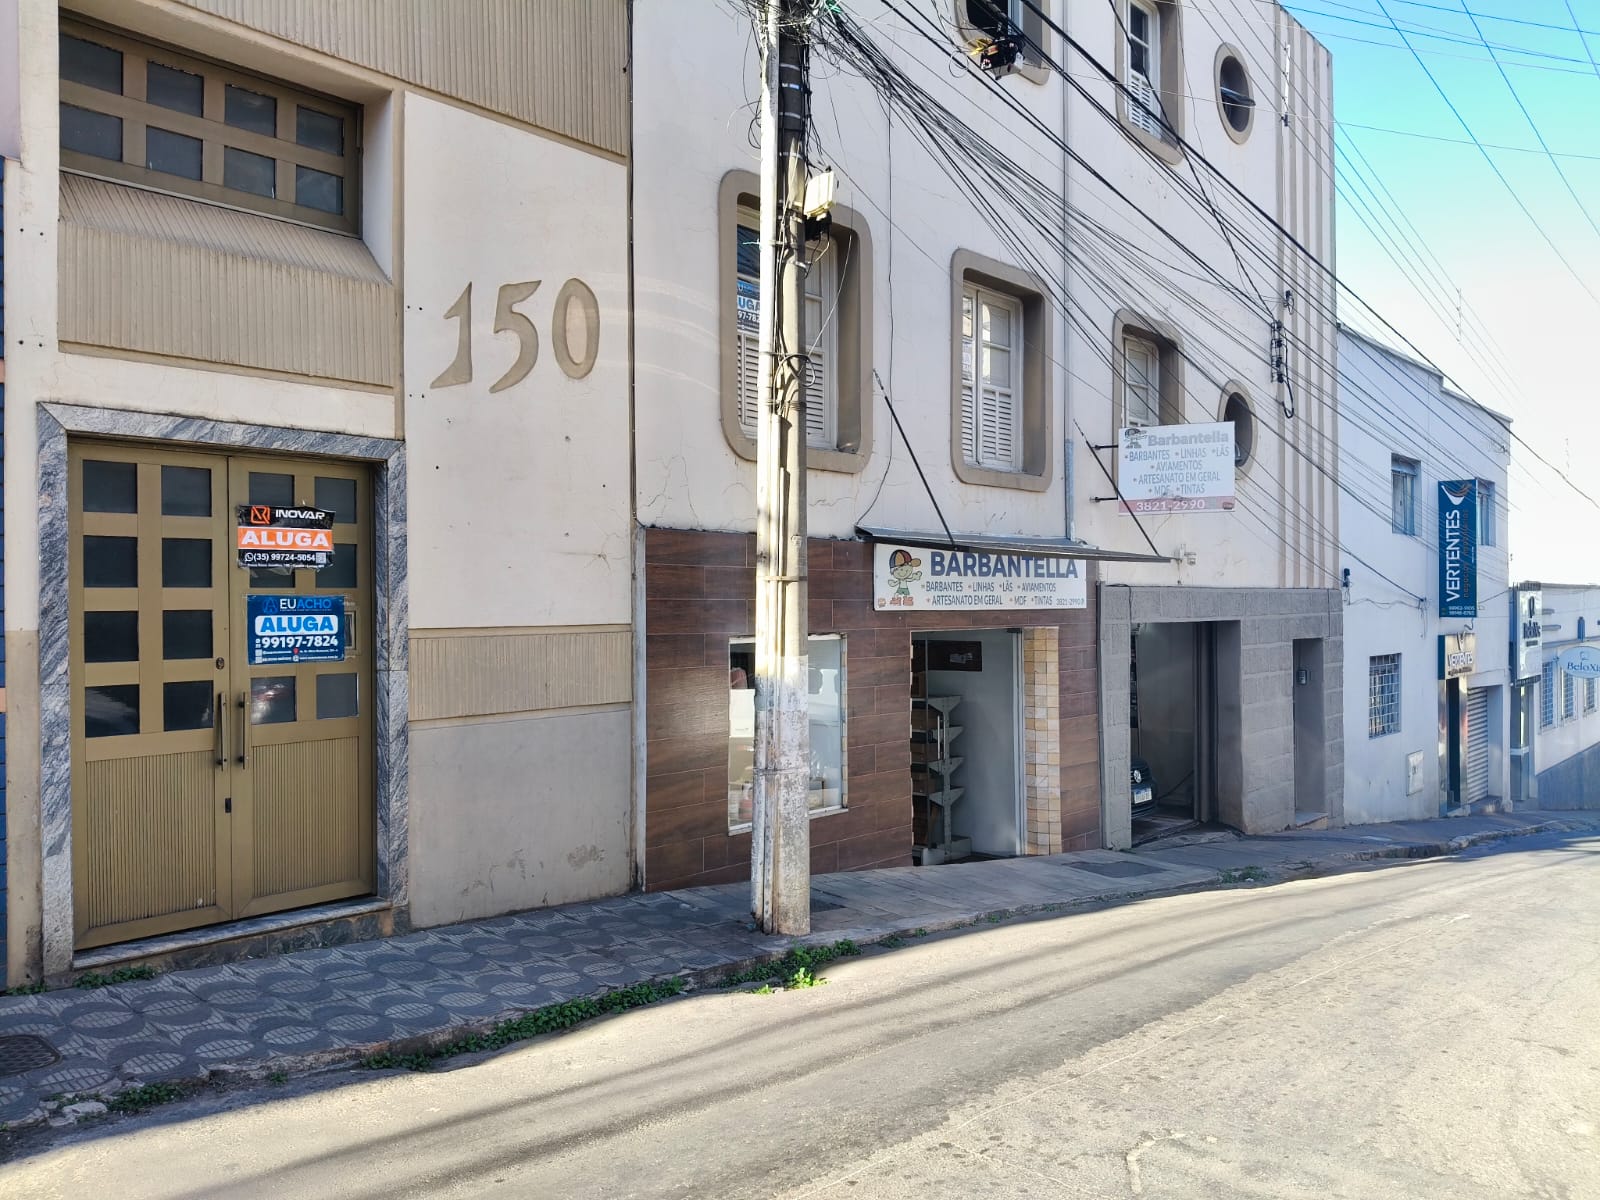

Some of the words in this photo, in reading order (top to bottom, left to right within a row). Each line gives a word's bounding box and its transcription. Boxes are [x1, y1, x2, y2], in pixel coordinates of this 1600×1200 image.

[430, 277, 601, 394] 150
[1148, 431, 1229, 447] Barbantella
[1130, 449, 1170, 461] BARBANTES
[1180, 448, 1207, 459] LINHAS
[1216, 446, 1229, 457] LÃS
[1156, 460, 1202, 471] AVIAMENTOS
[1138, 473, 1185, 485] ARTESANATO
[1185, 472, 1196, 482] EM
[1198, 471, 1220, 481] GERAL
[1180, 484, 1205, 495] TINTAS
[1136, 500, 1205, 511] 3821-2990
[275, 509, 325, 521] INOVAR
[241, 530, 329, 547] ALUGA
[253, 552, 269, 561] (35)
[271, 553, 315, 562] 99724-5054
[1446, 510, 1460, 602] VERTENTES
[930, 551, 1078, 578] BARBANTELLA
[926, 581, 964, 592] BARBANTES
[972, 582, 995, 592] LINHAS
[1022, 582, 1056, 592] AVIAMENTOS
[280, 598, 332, 610] EUACHO
[932, 595, 972, 605] ARTESANATO
[974, 595, 983, 605] EM
[984, 595, 1003, 605] GERAL
[1034, 595, 1053, 606] TINTAS
[260, 615, 334, 633] ALUGA
[261, 635, 338, 648] 99197-7824
